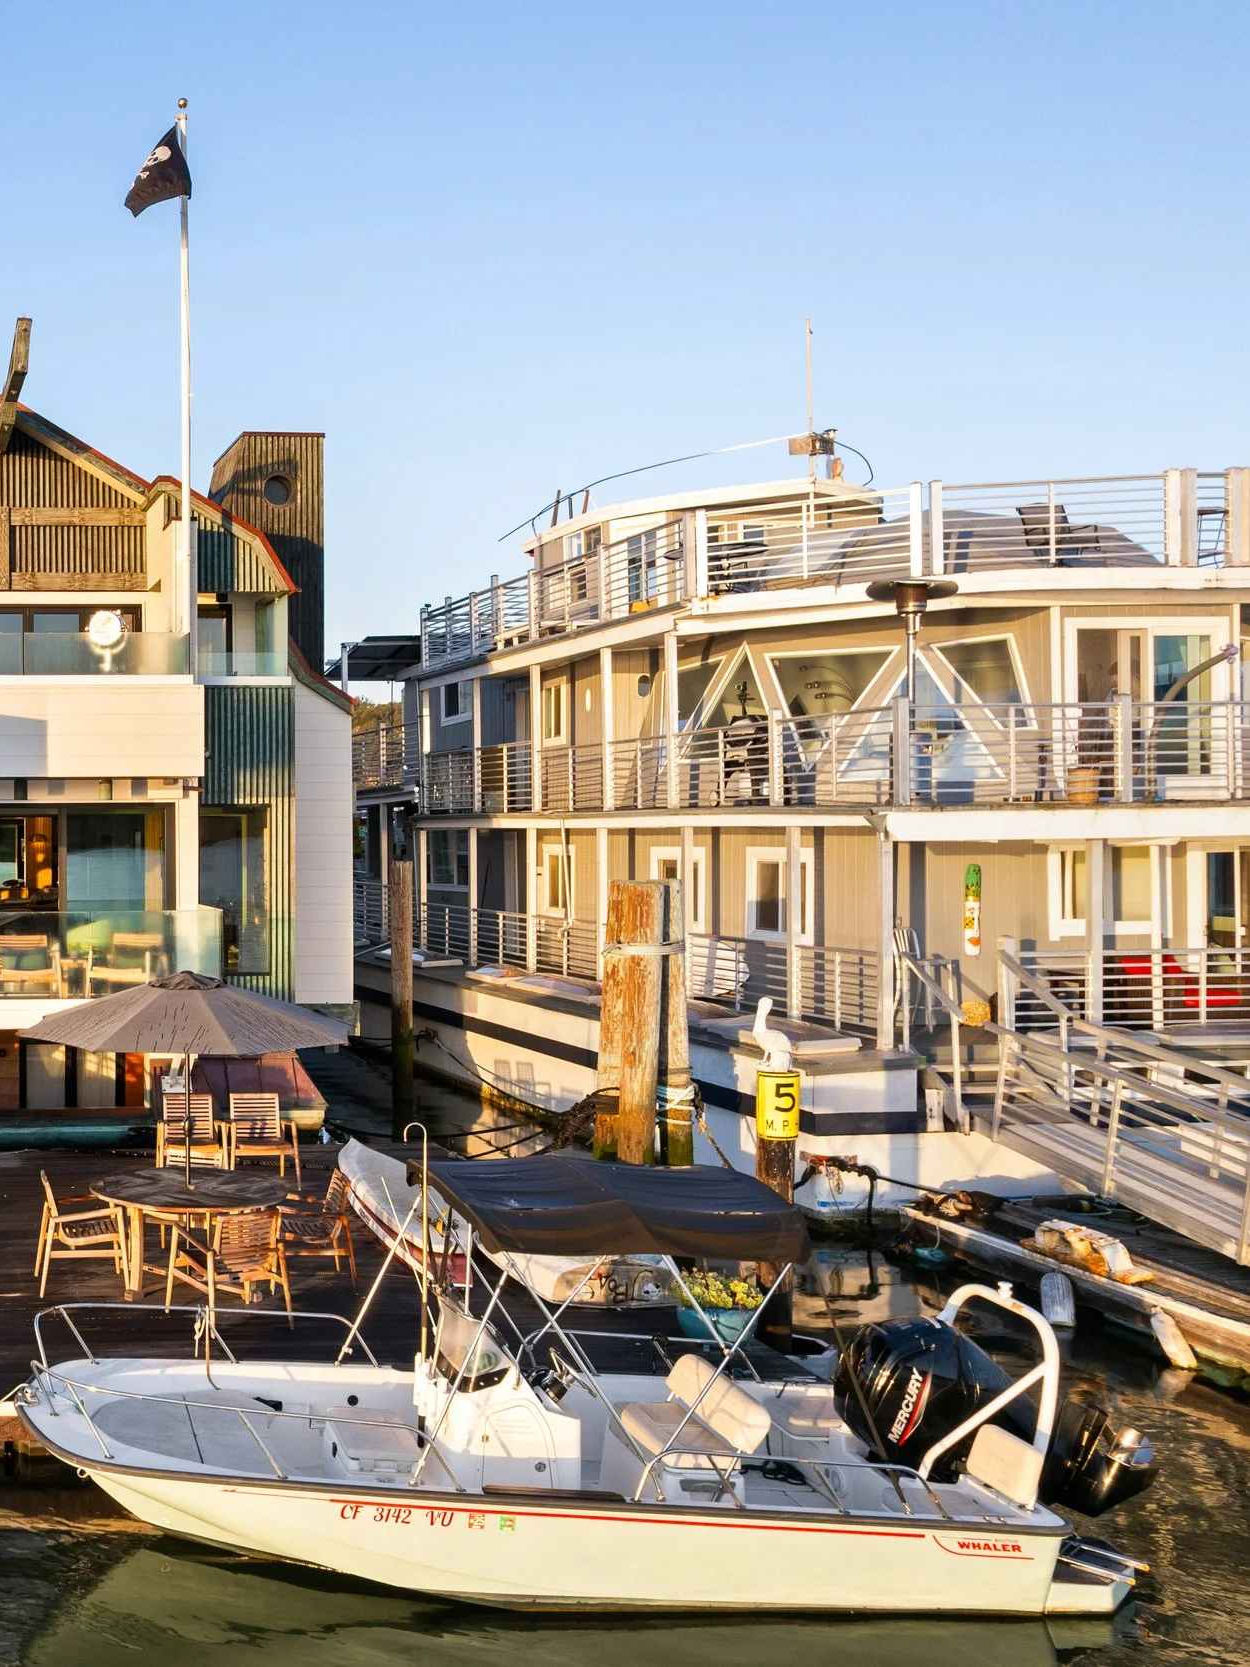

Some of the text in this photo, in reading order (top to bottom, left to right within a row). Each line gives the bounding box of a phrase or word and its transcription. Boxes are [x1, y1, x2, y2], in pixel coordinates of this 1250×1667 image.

[774, 1082, 796, 1113] 5
[887, 1366, 923, 1444] MERCURY
[340, 1504, 455, 1527] CF 3142 VU
[957, 1541, 1022, 1553] WHALER
